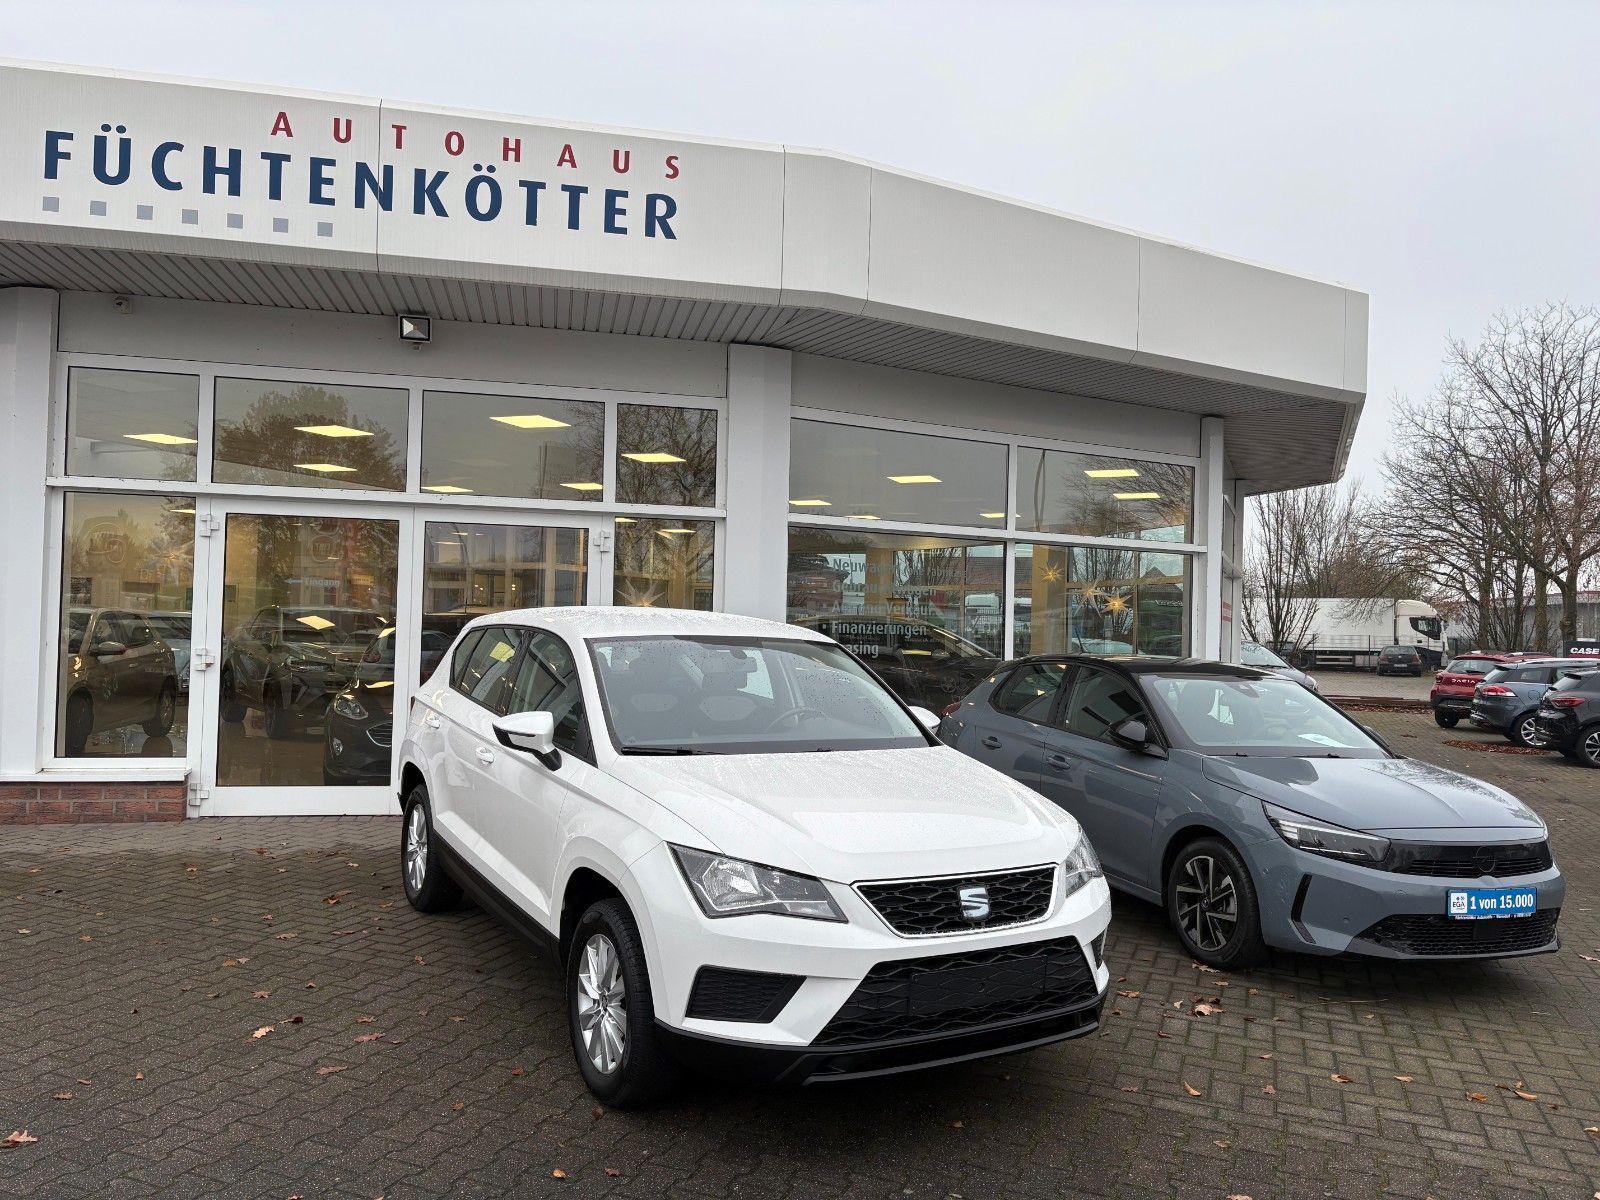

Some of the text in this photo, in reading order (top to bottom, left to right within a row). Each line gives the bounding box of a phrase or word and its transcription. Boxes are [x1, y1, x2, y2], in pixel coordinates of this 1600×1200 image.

[270, 111, 680, 180] AUTOHAUS
[43, 123, 679, 240] FÜCHTENKÖTTER
[831, 621, 927, 638] Finanzierungen
[845, 641, 879, 658] asing
[1470, 893, 1534, 910] 1 von 15.000
